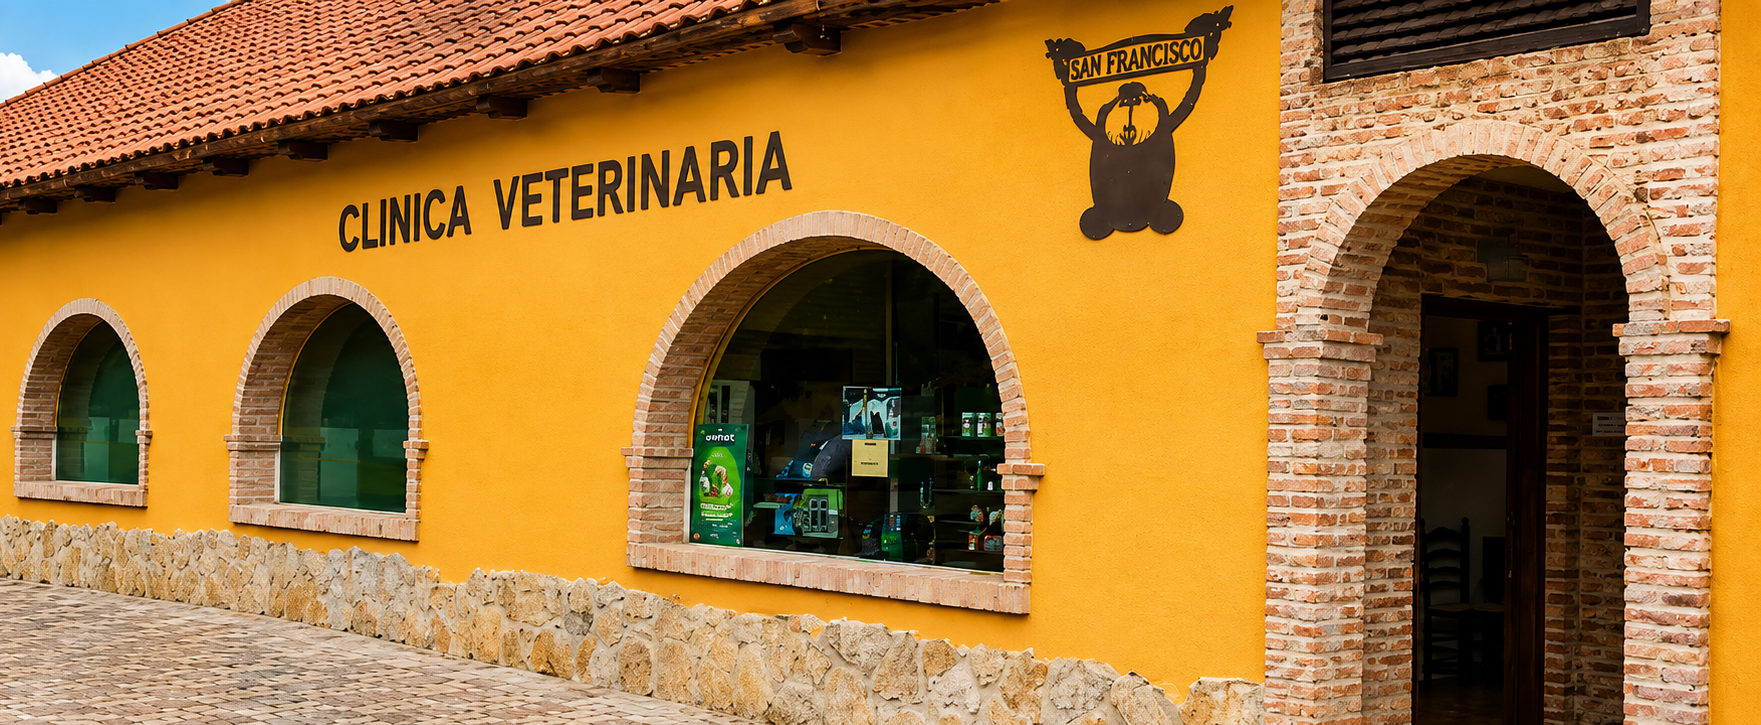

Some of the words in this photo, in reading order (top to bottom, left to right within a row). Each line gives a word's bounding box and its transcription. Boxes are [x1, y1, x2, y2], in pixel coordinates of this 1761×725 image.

[1071, 54, 1102, 80] SAN
[1106, 38, 1202, 75] FRANCISCO
[338, 185, 472, 252] CLINICA
[493, 131, 792, 230] VETERINARIA
